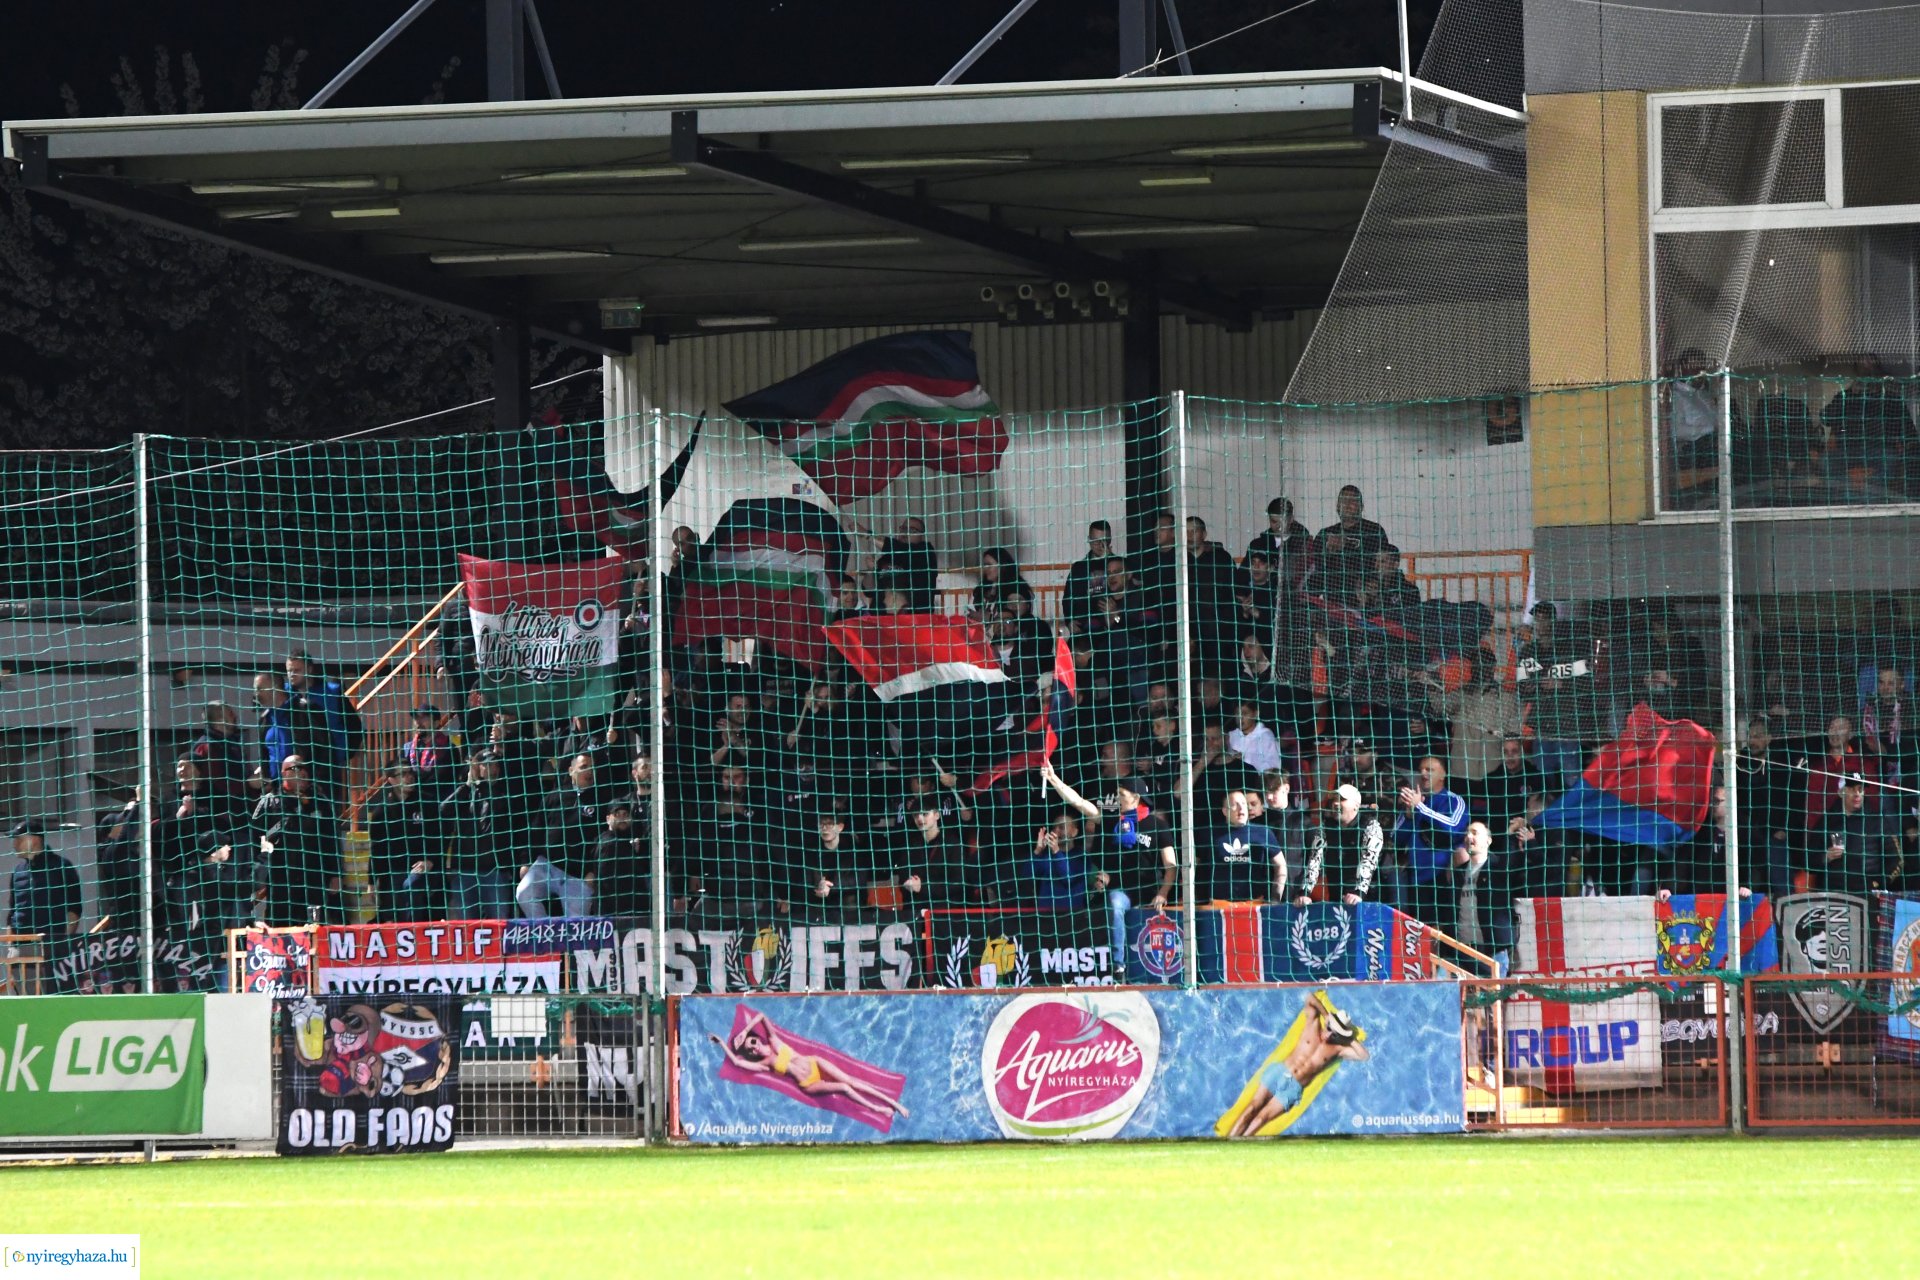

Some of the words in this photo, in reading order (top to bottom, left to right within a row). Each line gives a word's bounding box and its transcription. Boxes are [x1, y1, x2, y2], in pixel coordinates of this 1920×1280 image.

[1307, 926, 1339, 942] 1928
[1828, 905, 1850, 986] NYSF
[66, 1035, 178, 1075] LIGA
[995, 1030, 1142, 1121] Aquarius
[1047, 1074, 1137, 1087] NYÍREGYHÁZA
[288, 1108, 356, 1147] OLD
